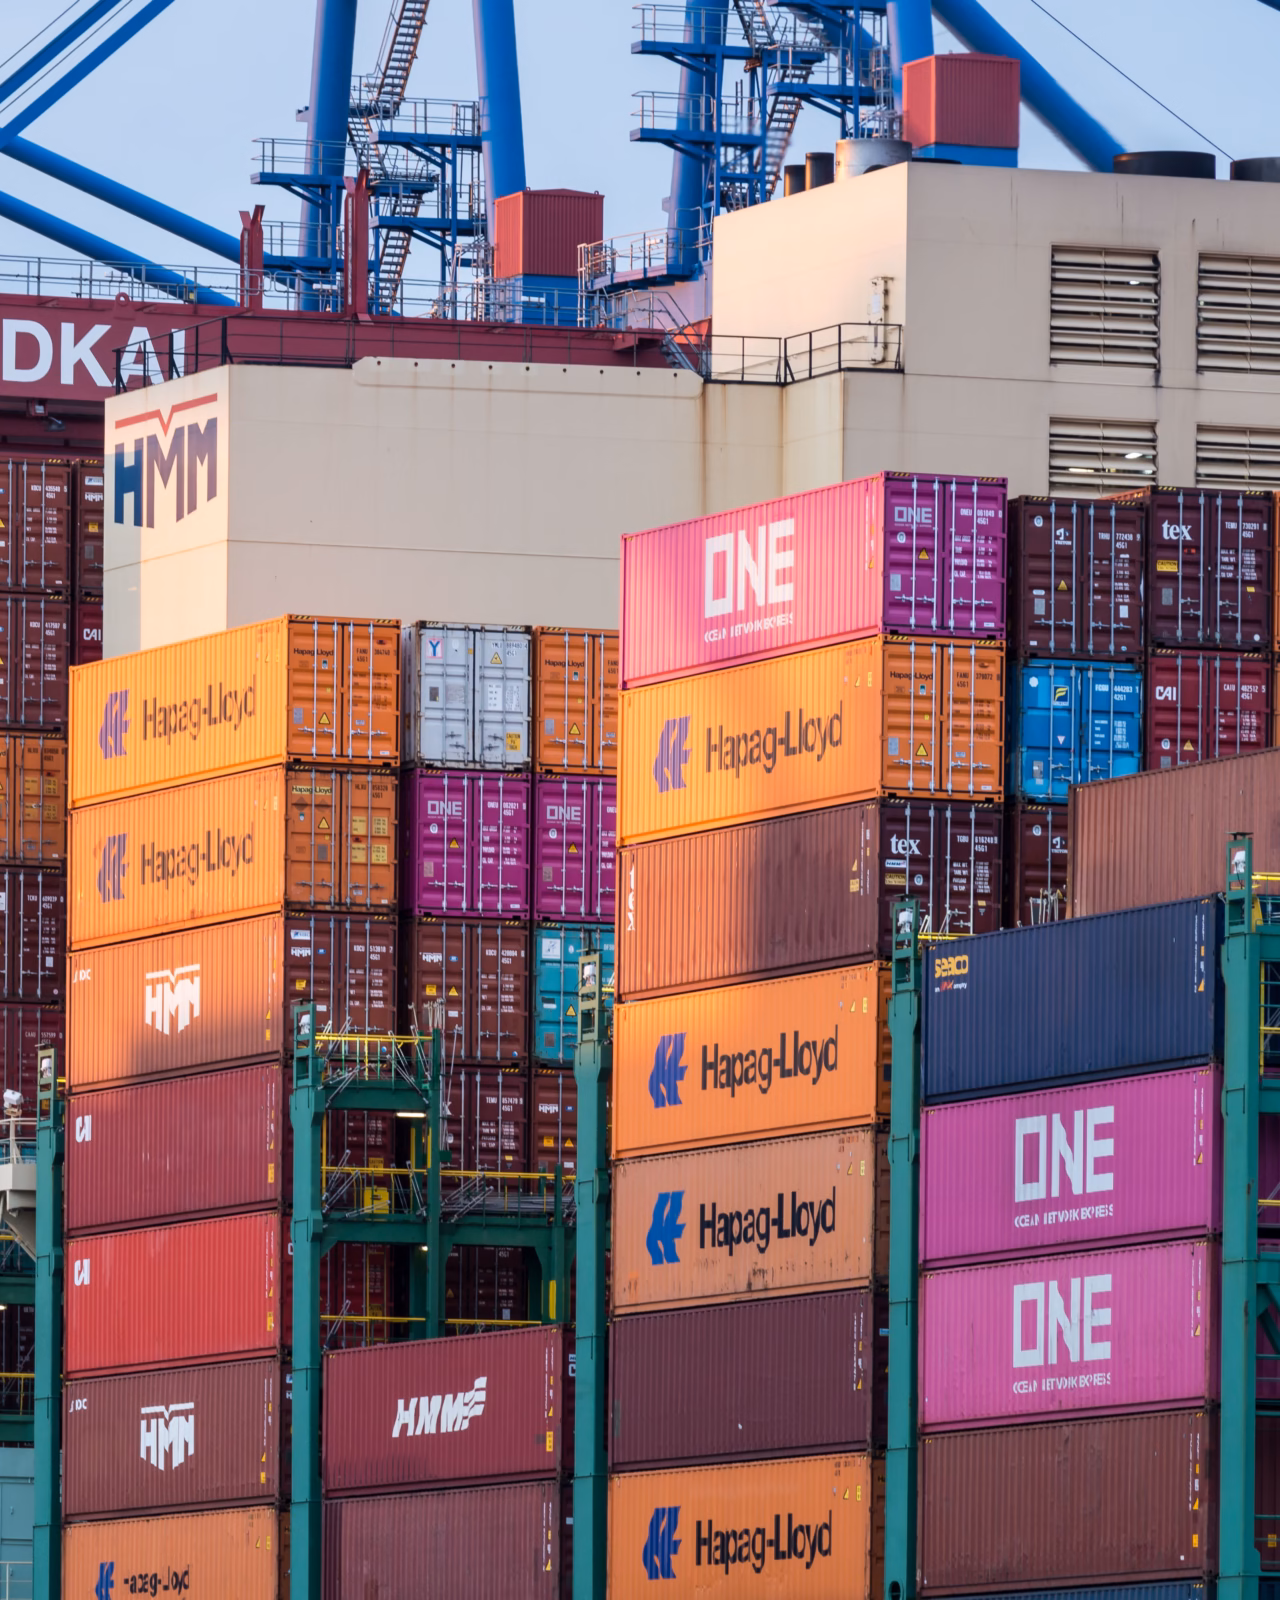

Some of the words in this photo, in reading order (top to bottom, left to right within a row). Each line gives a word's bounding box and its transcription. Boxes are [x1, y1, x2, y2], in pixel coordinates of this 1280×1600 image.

[114, 415, 218, 529] HMM
[894, 506, 932, 523] ONE
[1162, 520, 1192, 540] tex
[704, 516, 795, 619] ONE
[84, 628, 101, 641] CAI
[294, 648, 334, 657] HapagLloyd
[544, 658, 584, 668] HapagLloyd
[1156, 686, 1176, 701] CAI
[143, 674, 256, 745] Hapag-Lloyd
[706, 700, 843, 780] Hapag-Lloyd
[292, 786, 332, 795] HapagLloyd
[428, 800, 462, 815] ONE
[546, 806, 581, 820] ONE
[141, 821, 255, 890] Hapag-Lloyd
[890, 834, 921, 855] tex
[934, 954, 969, 978] seaco
[701, 1024, 838, 1098] Hapag-Lloyd
[1014, 1105, 1115, 1203] ONE
[699, 1186, 836, 1256] Hapag-Lloyd
[1013, 1274, 1112, 1368] ONE
[695, 1510, 832, 1576] Hapag-Lloyd
